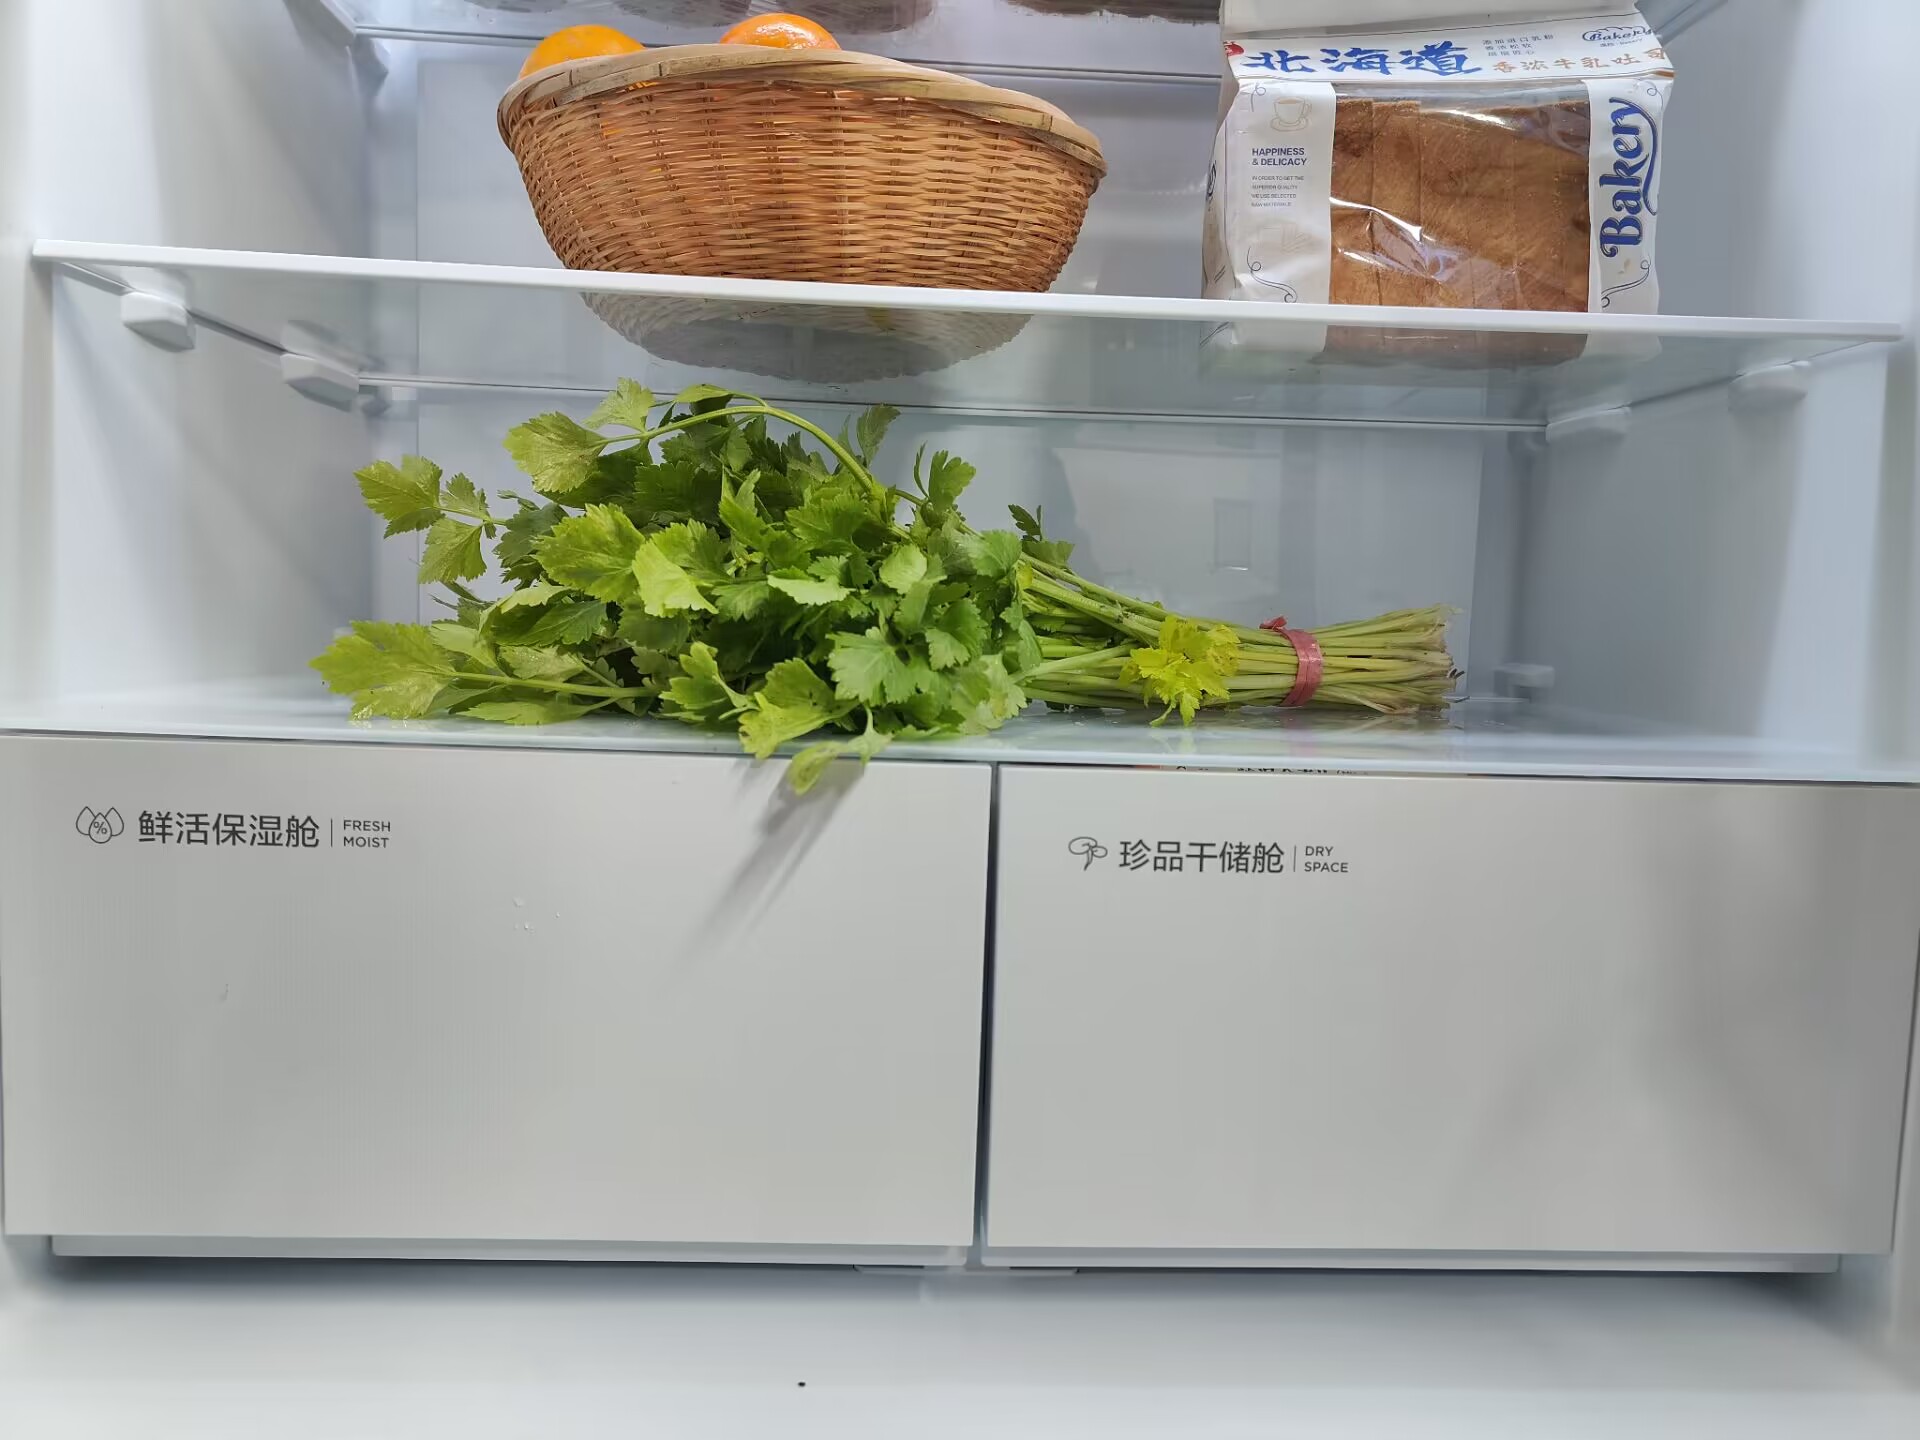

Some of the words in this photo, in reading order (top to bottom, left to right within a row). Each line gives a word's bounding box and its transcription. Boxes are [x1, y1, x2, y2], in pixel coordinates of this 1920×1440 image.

[1241, 40, 1482, 76] 北海道
[1493, 48, 1666, 73] 香浓牛乳吐司
[1251, 147, 1305, 156] HAPPINESS
[1251, 157, 1259, 166] &
[1260, 157, 1307, 166] DELICACY
[1599, 97, 1658, 258] Bakery
[138, 810, 320, 848] 鲜活保湿舱
[343, 819, 391, 833] FRESH
[343, 836, 389, 849] MOIST
[1119, 838, 1285, 874] 珍品干储舱
[1304, 845, 1333, 857] DRY
[1304, 861, 1349, 873] SPACE
